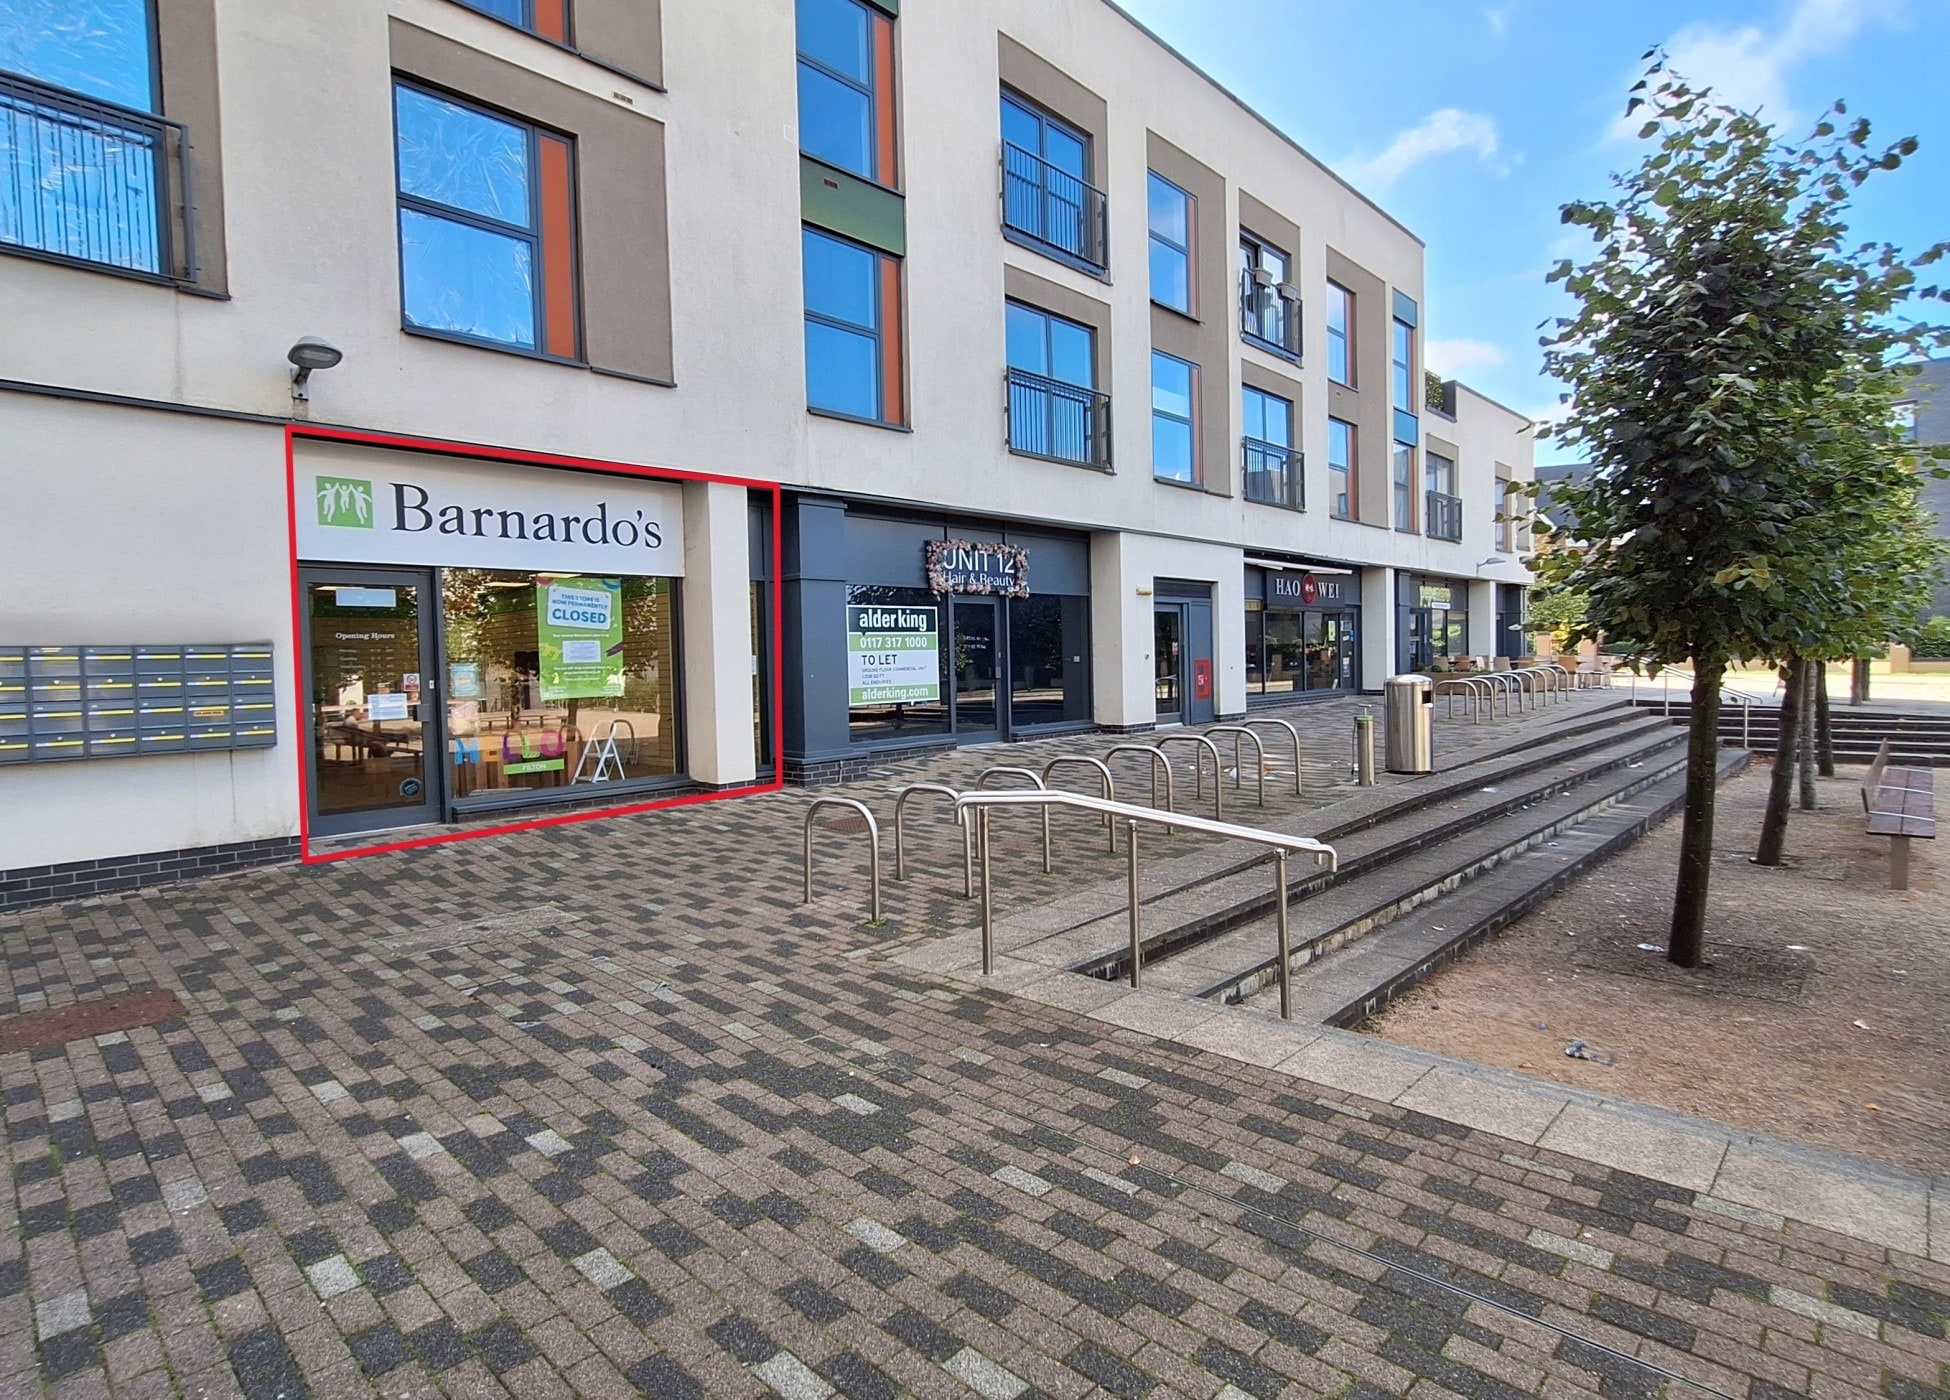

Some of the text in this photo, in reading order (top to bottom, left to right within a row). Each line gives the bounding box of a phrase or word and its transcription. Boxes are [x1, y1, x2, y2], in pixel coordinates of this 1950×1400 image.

[389, 482, 661, 549] Barnardo's
[943, 549, 1015, 573] UNIT 12
[944, 571, 1015, 586] Hair & Beauty
[1276, 578, 1300, 596] HAO
[1318, 582, 1339, 598] WEI
[552, 608, 607, 623] CLOSED
[335, 632, 369, 640] Opening
[860, 637, 927, 648] 0117 317 1000
[861, 654, 897, 665] TO LET
[861, 687, 929, 699] alderking.com
